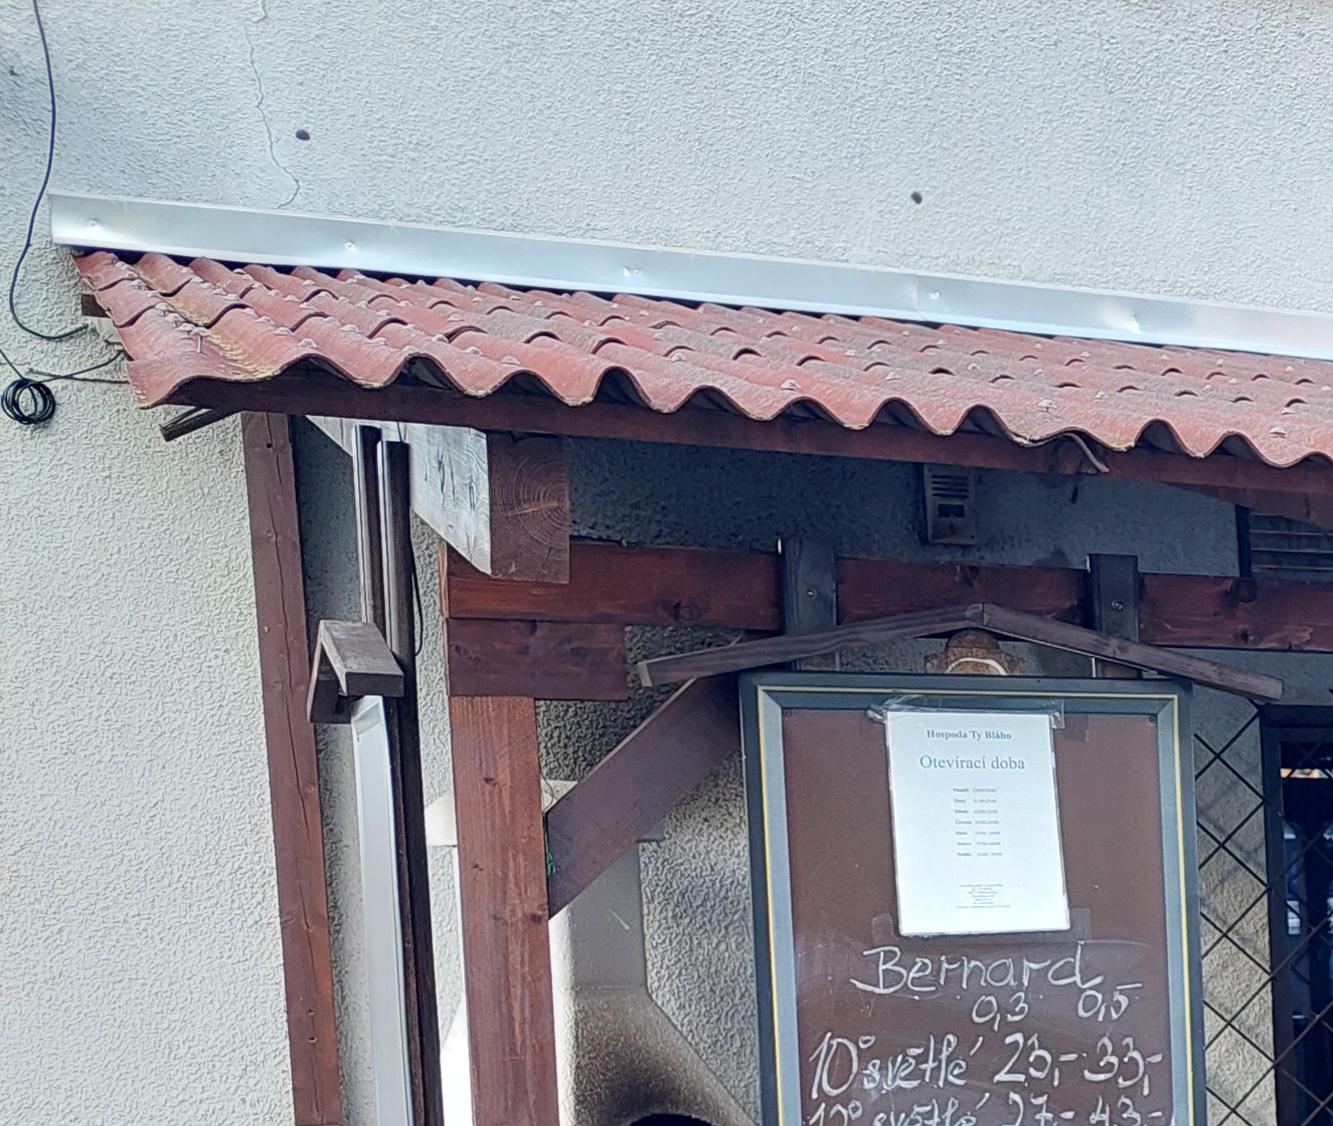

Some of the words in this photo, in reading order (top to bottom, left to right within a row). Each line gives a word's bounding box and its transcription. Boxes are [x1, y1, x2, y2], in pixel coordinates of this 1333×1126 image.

[926, 729, 968, 741] Hospoda
[971, 730, 982, 742] Ty
[985, 730, 1012, 740] Bláho
[919, 755, 986, 770] Otevírací
[991, 756, 1026, 770] doba
[849, 941, 1104, 993] Bernard
[971, 991, 1029, 1032] 0,3
[1077, 983, 1143, 1022] 0,5
[808, 1031, 876, 1099] 10°
